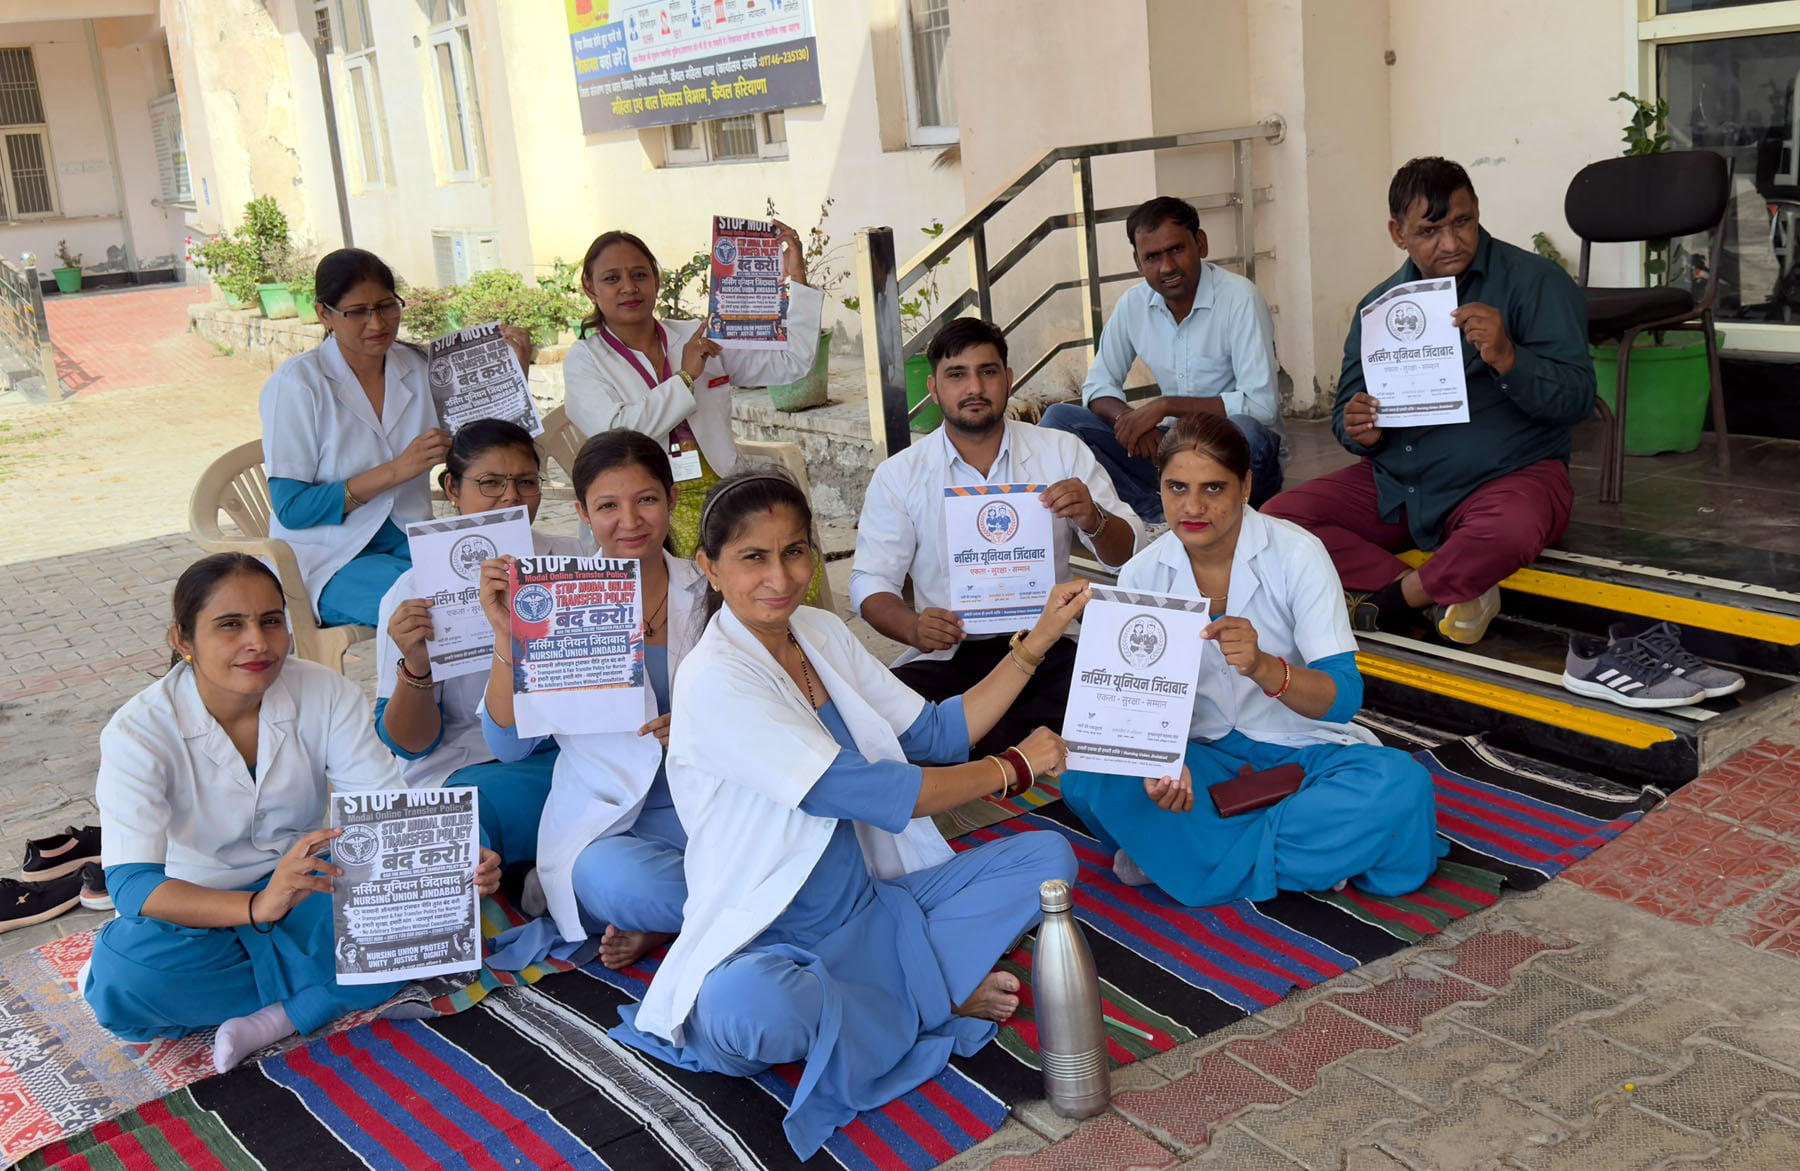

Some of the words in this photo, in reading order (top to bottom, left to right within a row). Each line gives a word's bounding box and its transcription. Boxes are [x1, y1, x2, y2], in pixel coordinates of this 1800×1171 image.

[611, 95, 632, 115] महिला
[659, 88, 683, 109] विकास
[734, 75, 767, 99] हरियाणा
[719, 217, 745, 229] STOP
[738, 257, 752, 271] बंद
[435, 334, 458, 352] STOP
[1368, 348, 1391, 363] नर्सिंग
[1393, 347, 1420, 363] यूनियन
[1422, 345, 1454, 358] जिंदाबाद
[457, 370, 478, 386] बंद
[481, 359, 513, 379] करो!
[954, 549, 978, 563] नर्सिंग
[981, 549, 1011, 565] यूनियन
[1013, 547, 1045, 560] जिंदाबाद
[521, 557, 571, 574] STOP
[525, 574, 547, 582] Modal
[607, 571, 628, 579] Policy
[457, 587, 480, 605] यूनि
[556, 583, 577, 594] STOP
[580, 582, 606, 592] MODAL
[608, 581, 635, 591] ONLINE
[556, 594, 602, 607] TRANSFER
[604, 592, 635, 603] POLICY
[556, 607, 585, 627] बंद
[589, 604, 634, 624] करो!
[529, 638, 554, 650] नर्सिंग
[557, 637, 587, 653] यूनियन
[590, 634, 626, 645] जिंदाबाद
[530, 650, 563, 660] NURSING
[565, 648, 588, 657] UNION
[590, 645, 626, 655] JINDABAD
[1081, 668, 1112, 686] नर्सिंग
[1113, 673, 1150, 692] यूनियन
[1152, 676, 1189, 695] जिंदाबाद
[1097, 693, 1116, 702] एकता
[1122, 696, 1140, 706] सुरक्षा
[1146, 700, 1167, 709] सम्मान
[344, 793, 400, 814] STOP
[348, 814, 374, 823] Modal
[375, 810, 401, 820] Online
[405, 806, 437, 816] Transfer
[440, 804, 464, 813] Policy
[382, 821, 405, 835] STOP
[408, 817, 438, 830] MODAL
[441, 813, 473, 826] ONLINE
[382, 830, 434, 849] TRANSFER
[437, 826, 472, 841] POLICY
[382, 848, 415, 870] बंद
[420, 841, 470, 865] करो!
[352, 882, 380, 895] नर्सिंग
[383, 880, 417, 896] यूनियन
[420, 876, 460, 888] जिंदाबाद
[354, 895, 390, 905] NURSING
[393, 892, 418, 901] UNION
[420, 886, 461, 899] JINDABAD
[367, 950, 396, 960] NURSING
[398, 947, 418, 956] UNION
[420, 942, 449, 952] PROTEST
[369, 960, 387, 968] UNITY
[393, 955, 418, 965] JUSTICE
[424, 949, 448, 959] DIGNITY
